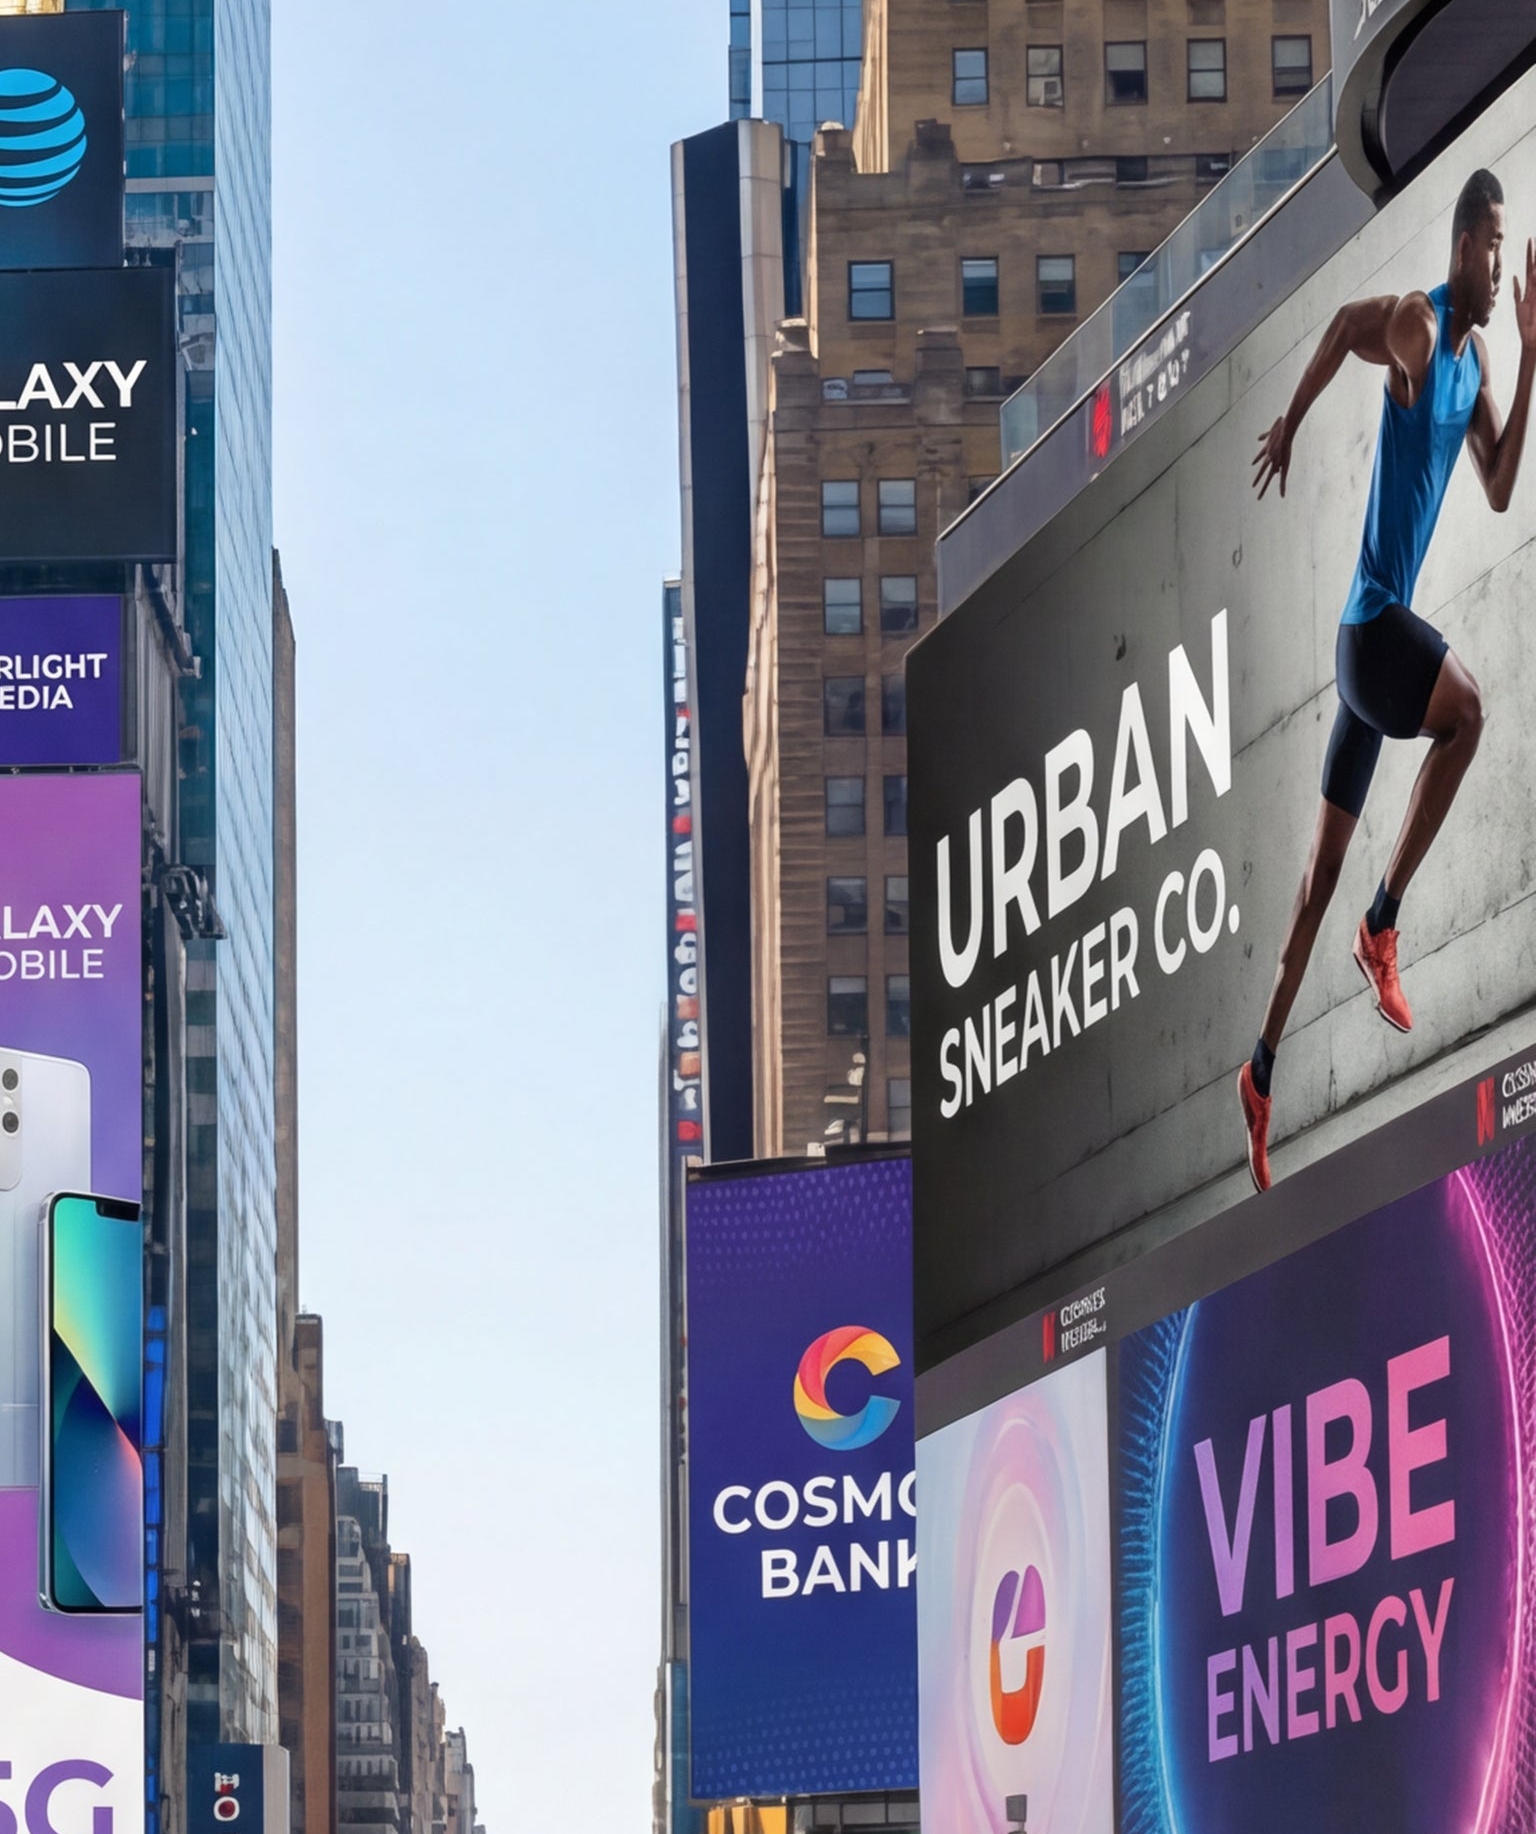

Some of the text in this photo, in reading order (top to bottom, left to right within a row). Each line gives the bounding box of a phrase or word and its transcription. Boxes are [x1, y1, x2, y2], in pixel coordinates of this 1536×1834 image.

[937, 607, 1232, 988] URBAN
[939, 848, 1240, 1119] SNEAKER CO.
[1193, 1335, 1457, 1617] VIBE
[1207, 1578, 1456, 1763] ENERGY
